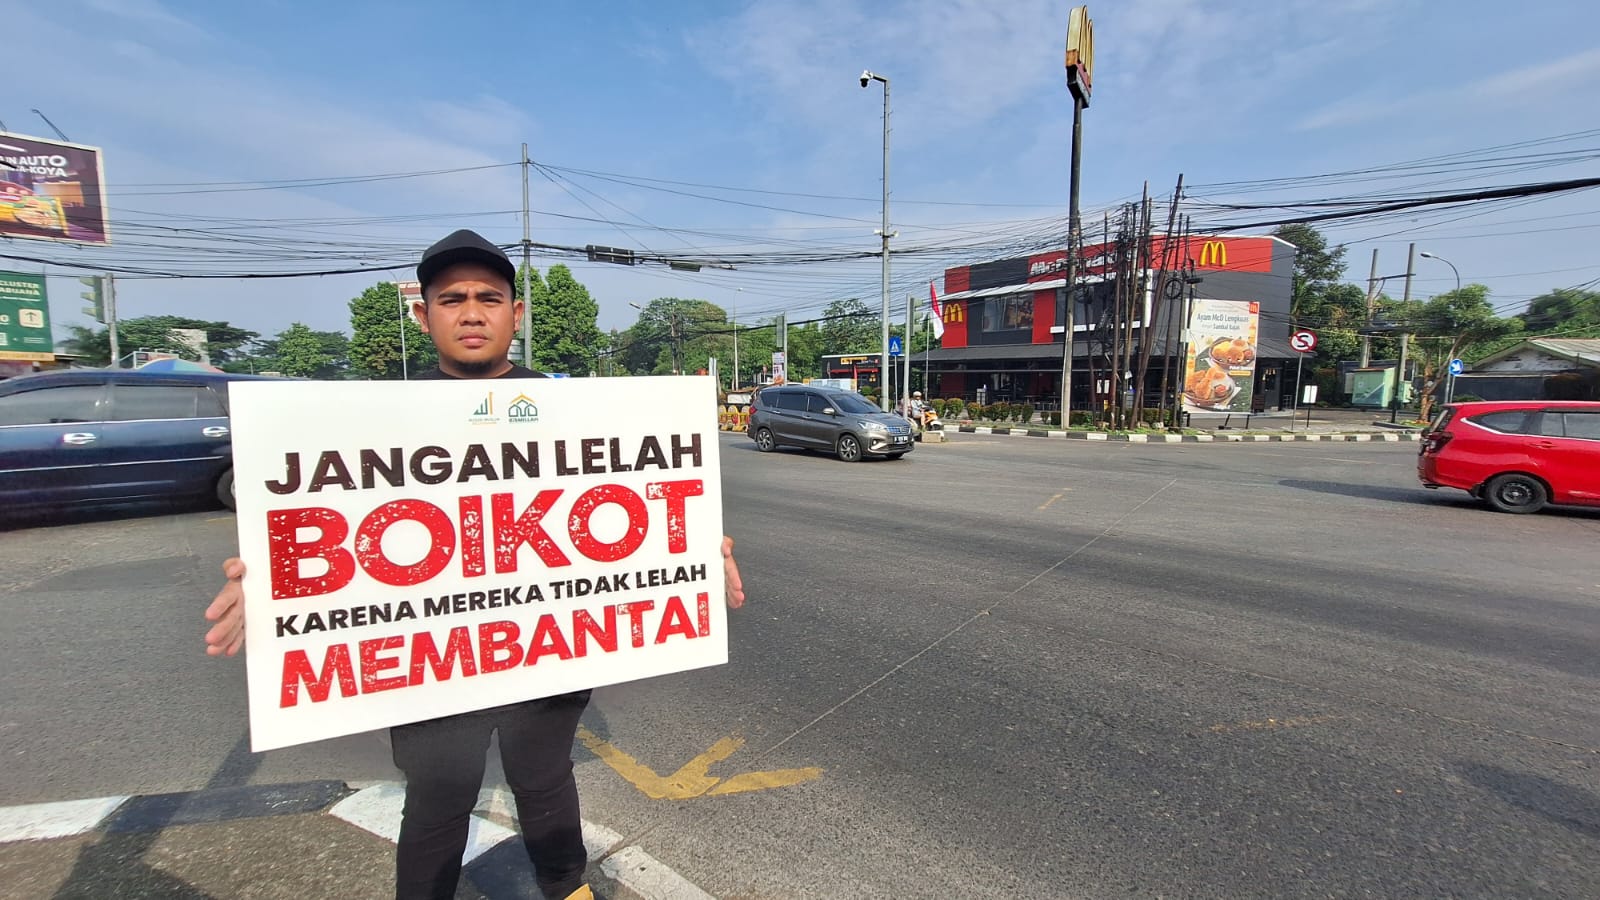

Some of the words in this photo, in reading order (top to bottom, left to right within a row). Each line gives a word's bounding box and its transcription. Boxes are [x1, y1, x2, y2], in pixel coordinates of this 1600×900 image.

[19, 155, 67, 167] AUTO
[265, 442, 540, 494] JANGAN
[555, 433, 703, 477] LELAH
[267, 479, 704, 600] BOIKOT
[276, 596, 416, 638] KARENA
[423, 583, 545, 618] MEREKA
[636, 563, 708, 591] LELAH
[280, 592, 711, 709] MEMBANTAI
